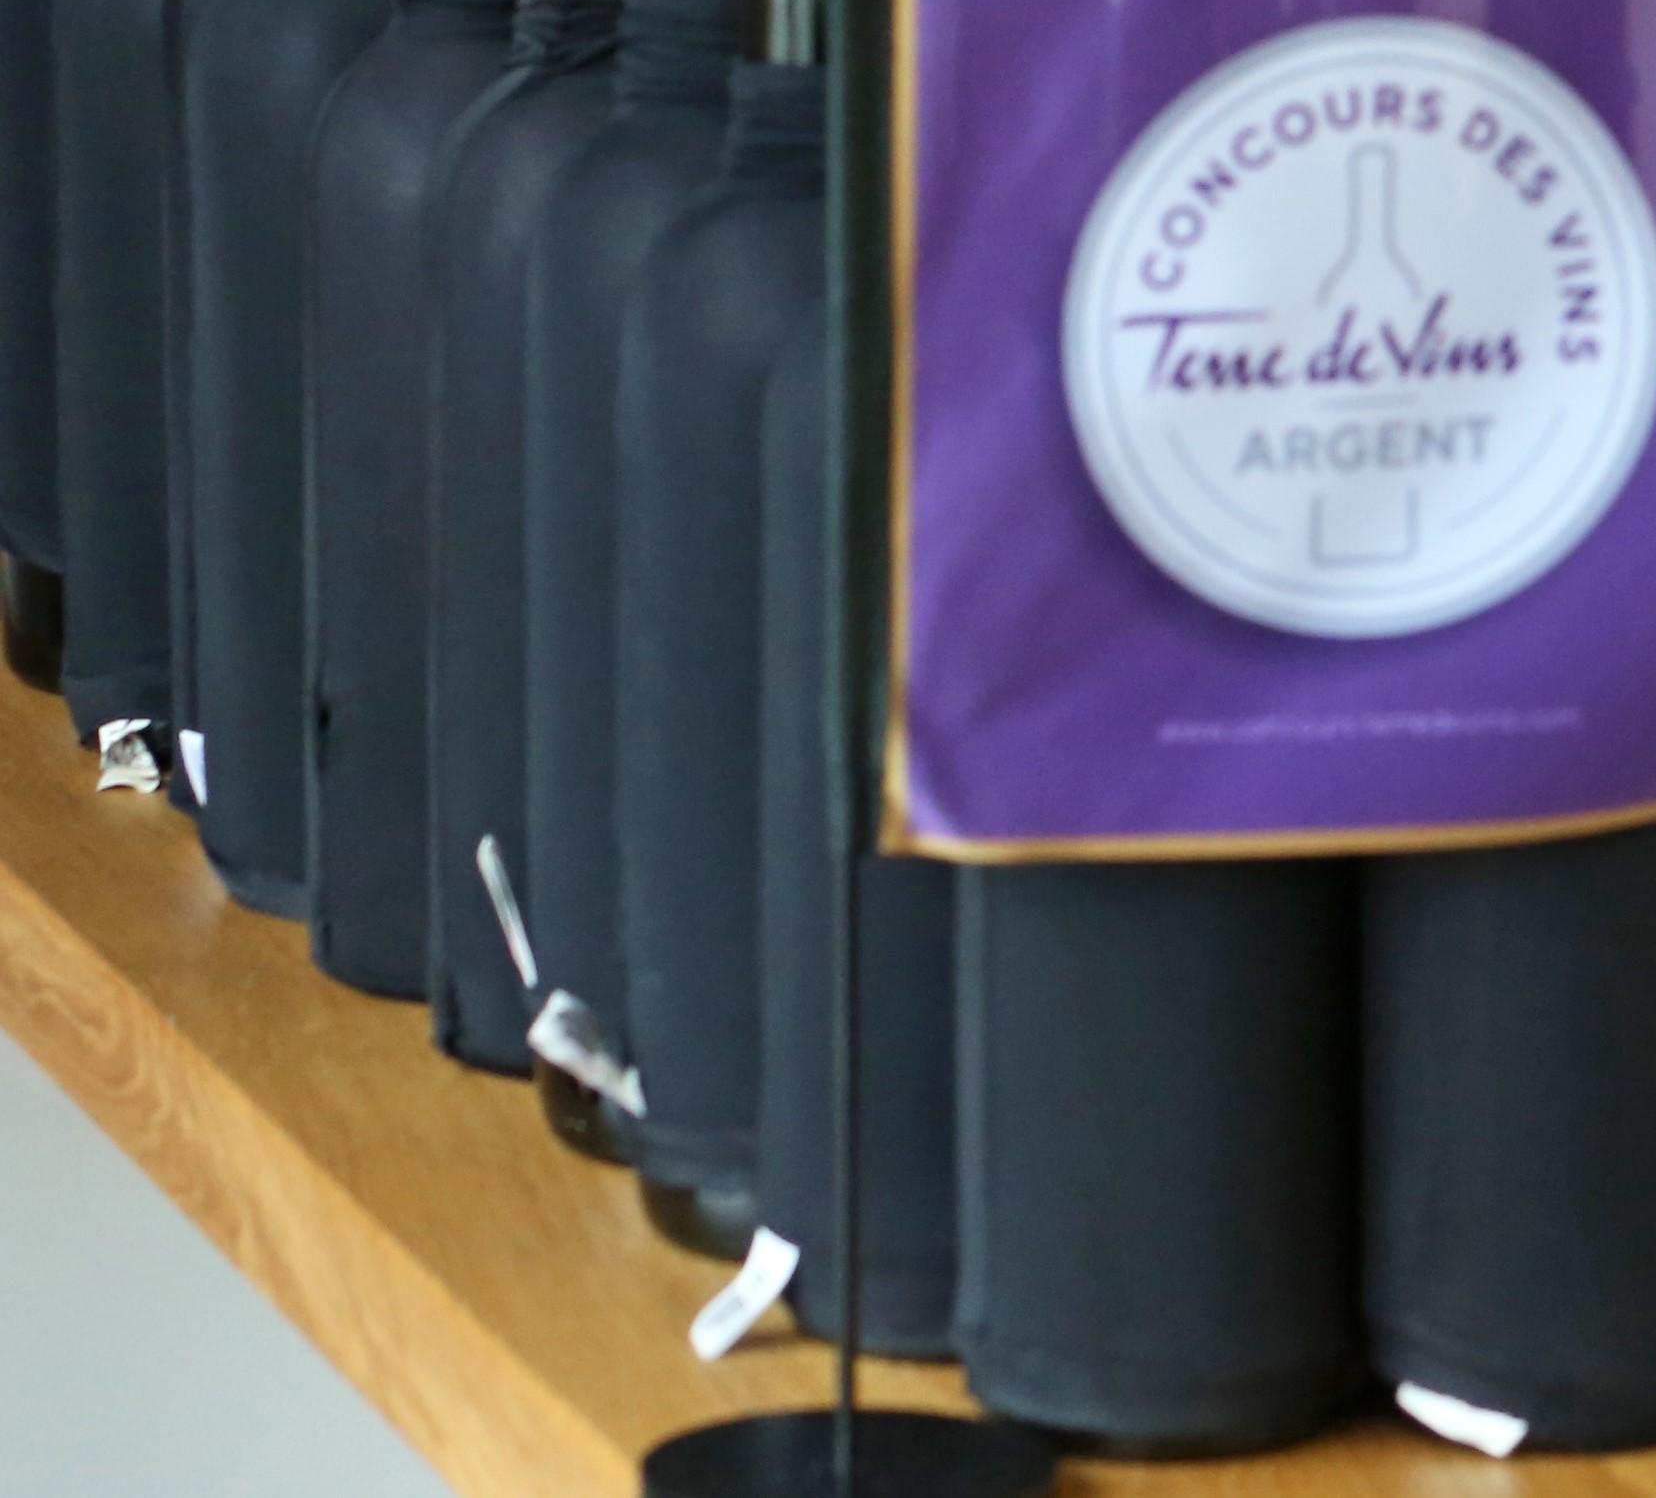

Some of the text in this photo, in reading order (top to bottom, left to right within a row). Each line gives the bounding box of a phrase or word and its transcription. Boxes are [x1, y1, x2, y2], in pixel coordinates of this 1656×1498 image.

[1139, 83, 1601, 365] CONCOURS DES VINS
[1234, 416, 1496, 475] ARGENT
